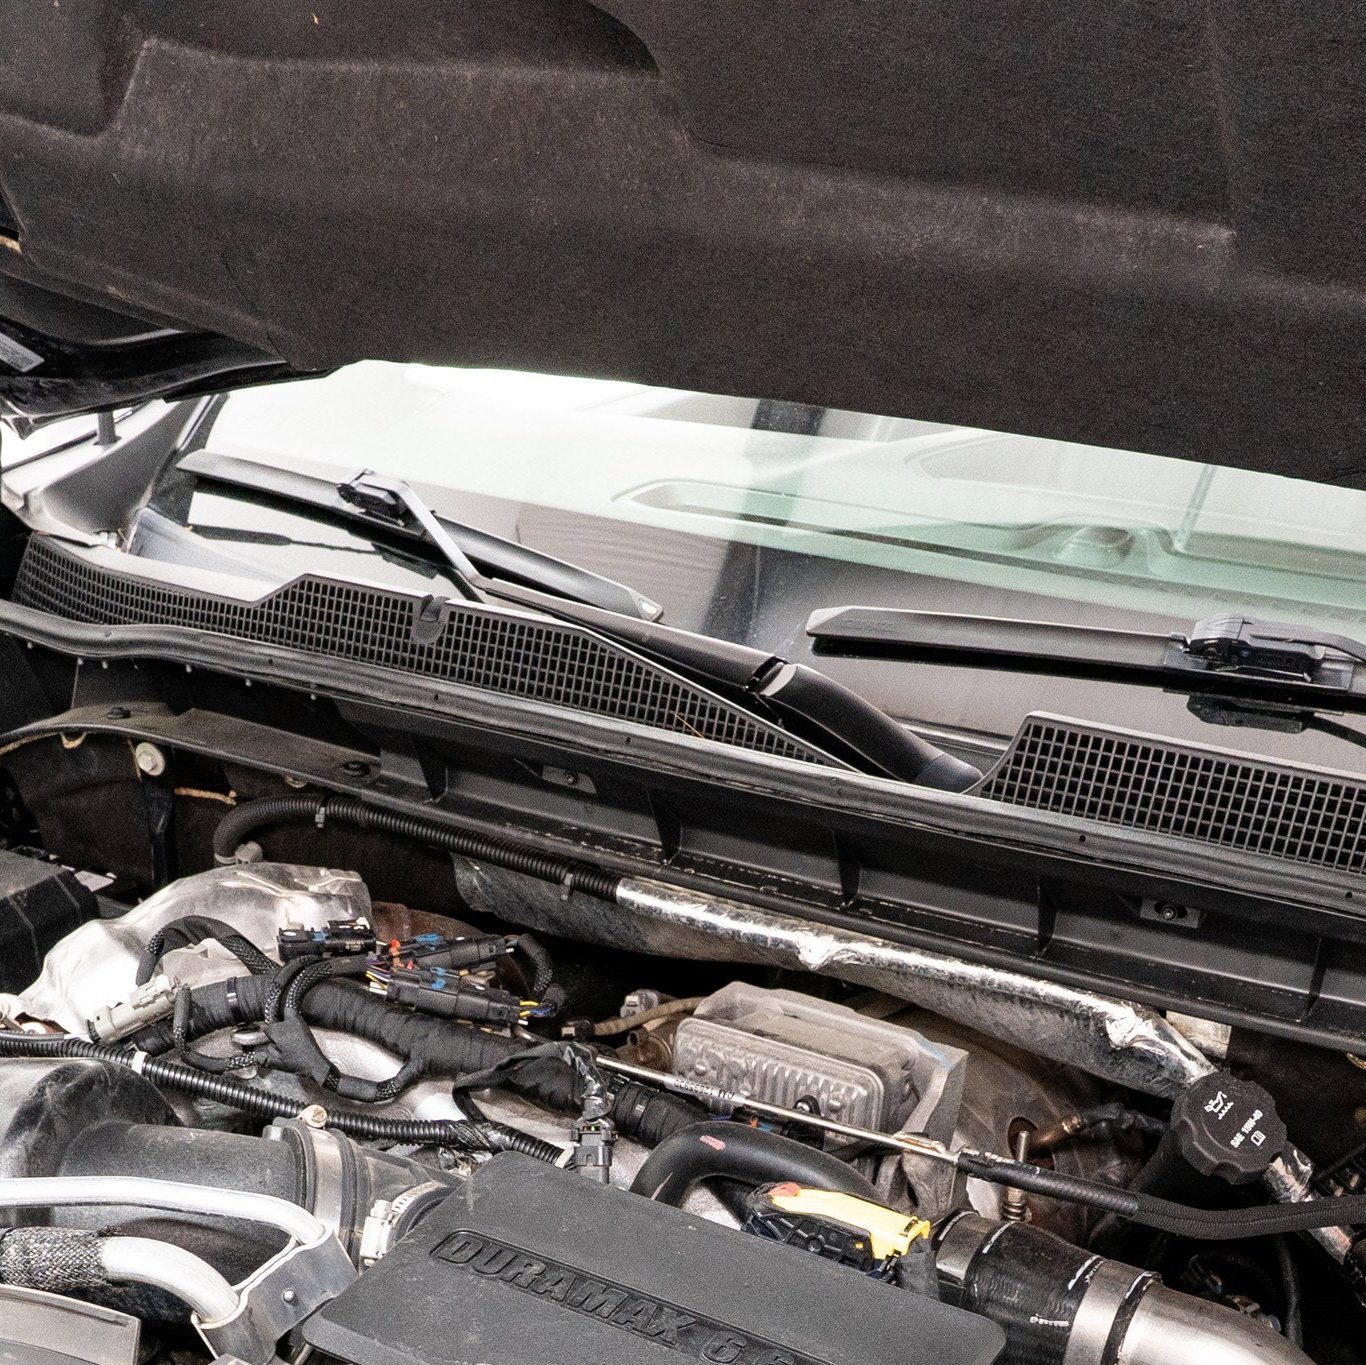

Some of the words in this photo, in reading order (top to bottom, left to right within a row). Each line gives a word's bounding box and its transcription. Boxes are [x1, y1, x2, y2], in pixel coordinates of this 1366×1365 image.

[1230, 1132, 1245, 1148] SAE
[1241, 1109, 1264, 1134] 15W-40
[436, 1232, 697, 1346] DURAMAX
